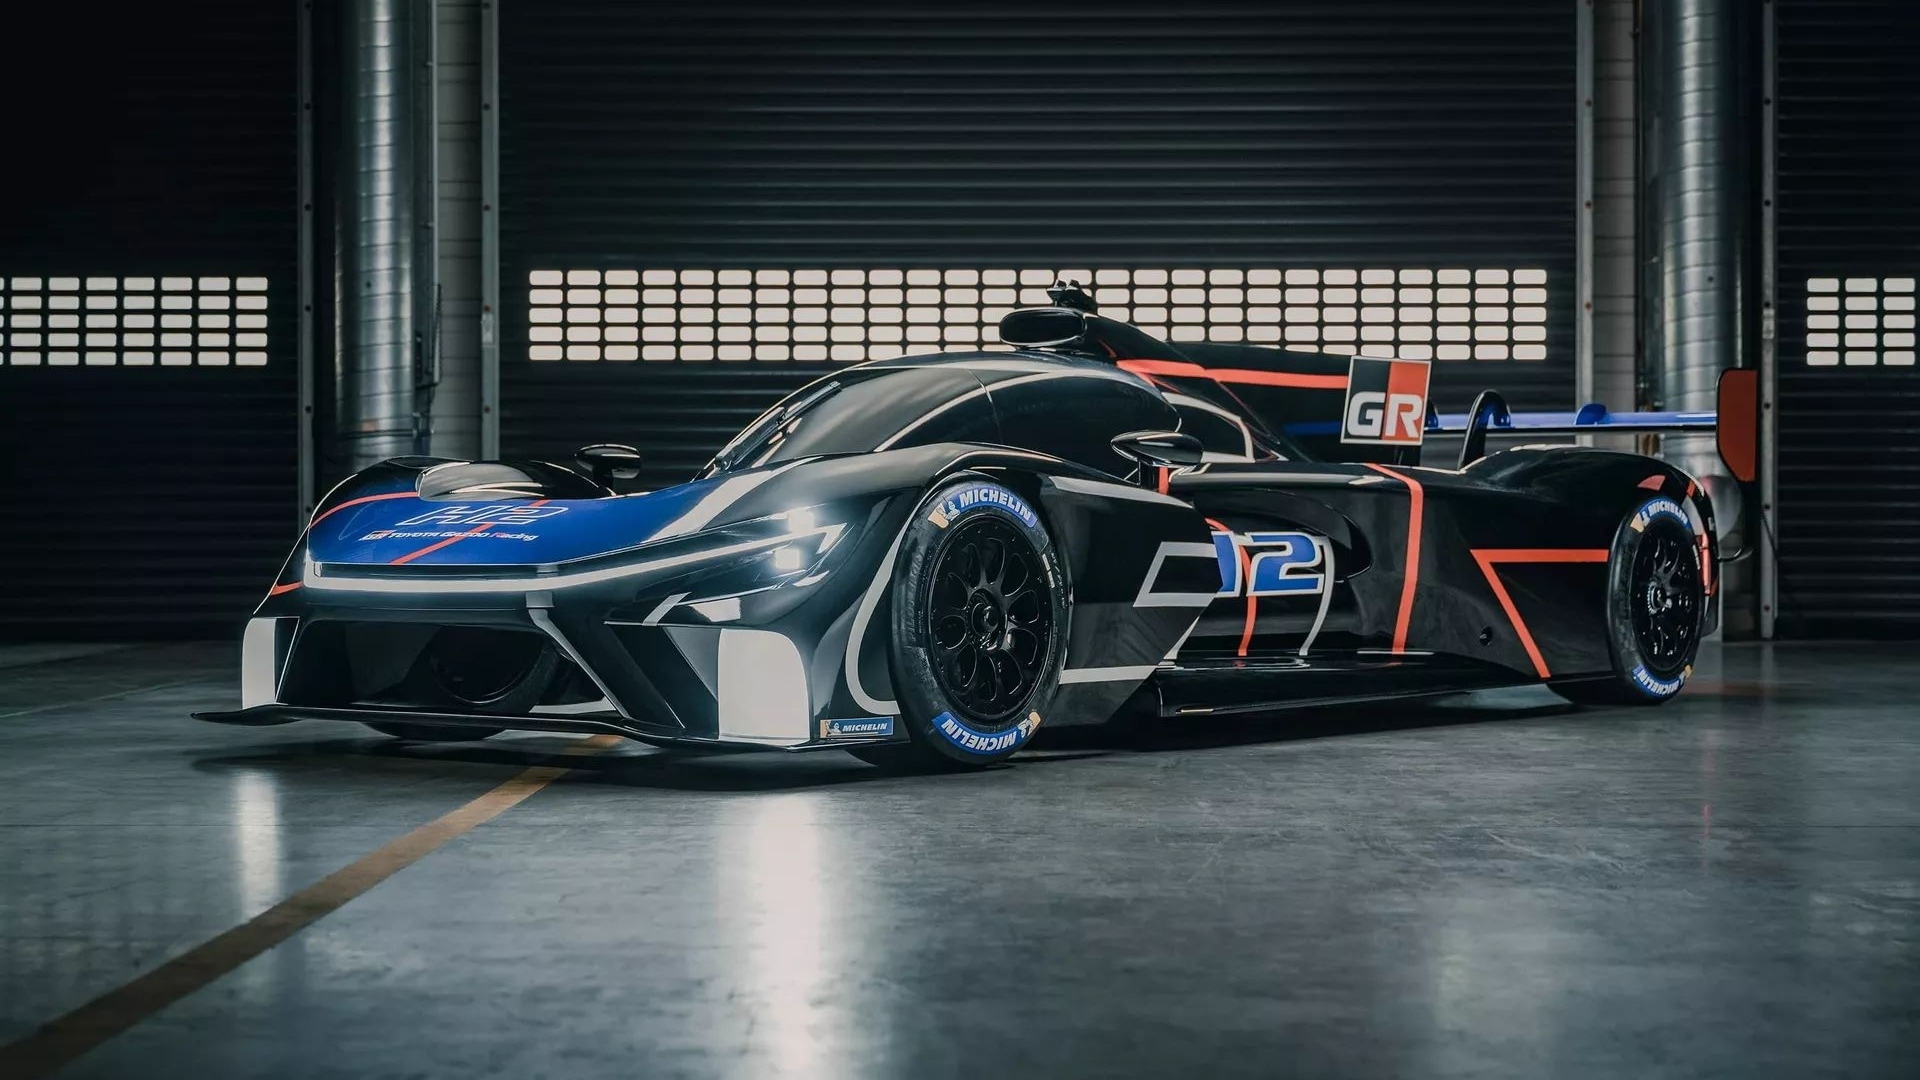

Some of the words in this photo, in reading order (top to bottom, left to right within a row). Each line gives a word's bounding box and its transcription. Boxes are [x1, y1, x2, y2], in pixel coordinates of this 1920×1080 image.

[1347, 391, 1423, 437] GR
[395, 506, 568, 526] H2
[959, 488, 1031, 520] MICHELIN
[1648, 500, 1688, 525] MICHELIN
[1637, 669, 1680, 695] MICHELIN
[842, 722, 888, 732] MICHELIN
[941, 718, 1017, 751] MICHELIN
